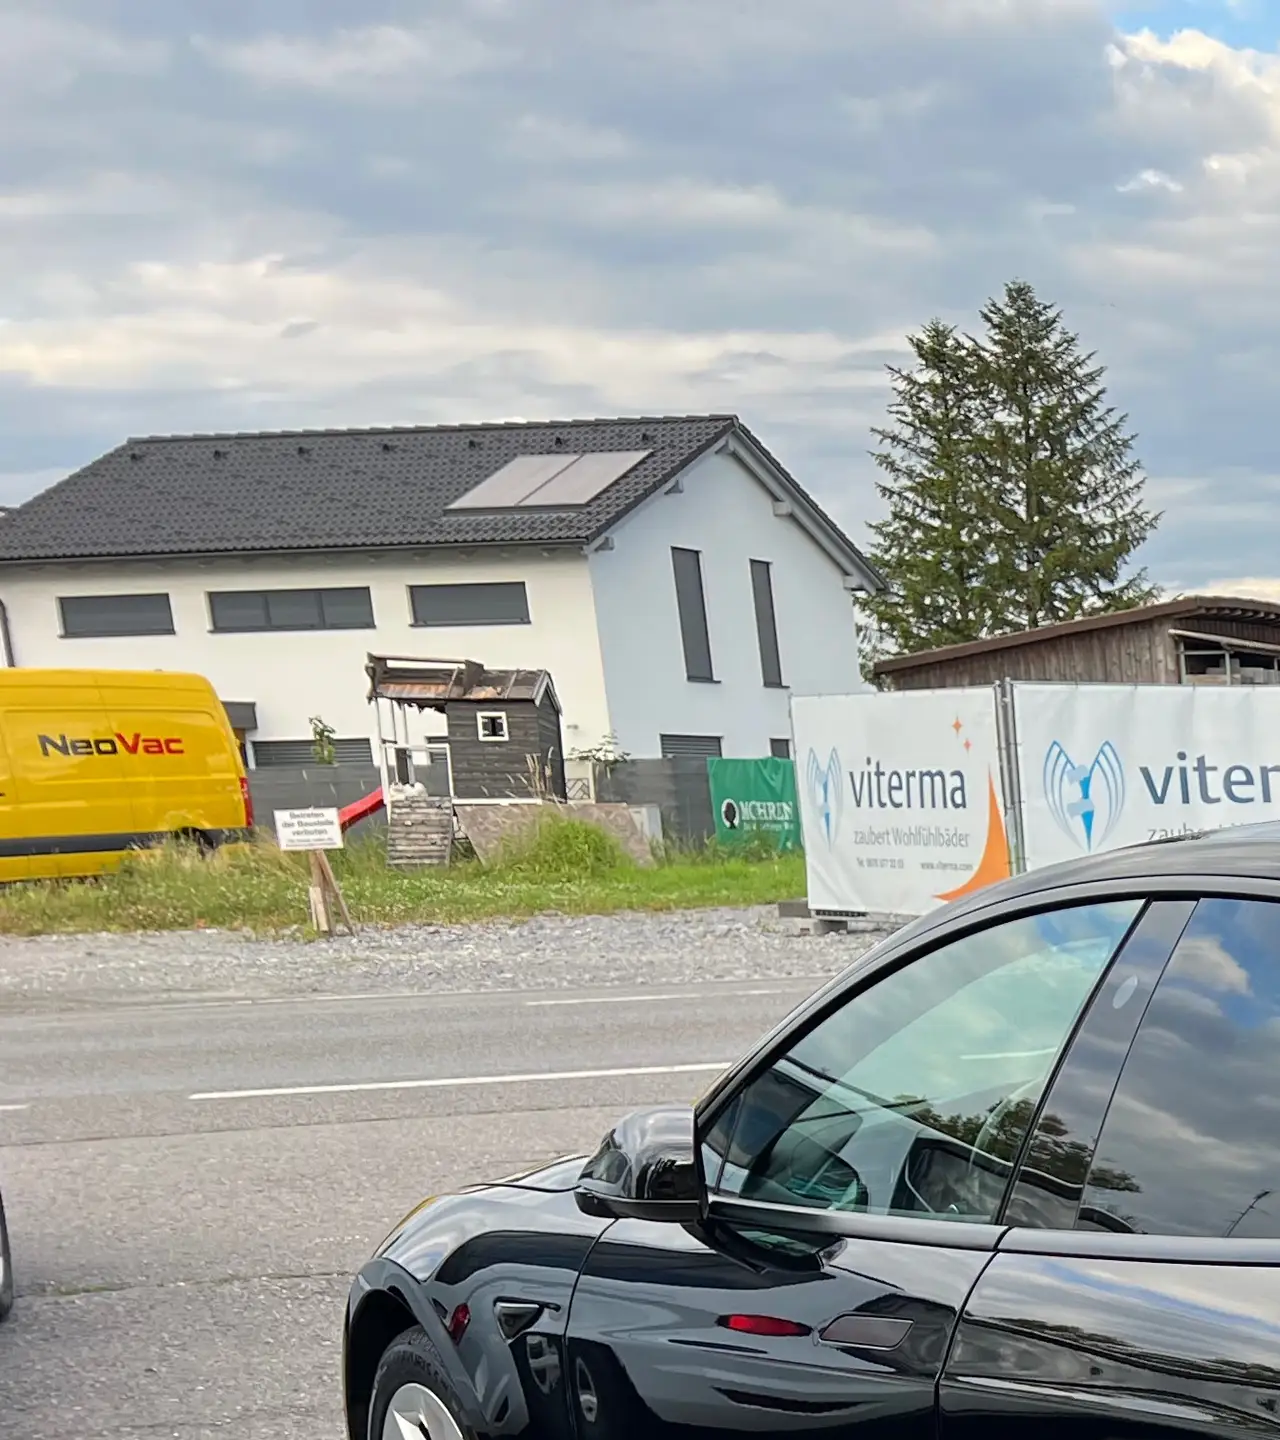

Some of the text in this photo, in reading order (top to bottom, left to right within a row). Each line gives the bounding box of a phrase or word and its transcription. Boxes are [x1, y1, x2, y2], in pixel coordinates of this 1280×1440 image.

[38, 733, 184, 757] NeoVac
[849, 756, 967, 810] viterma
[854, 825, 970, 848] zaubert Wohlfühlbäder
